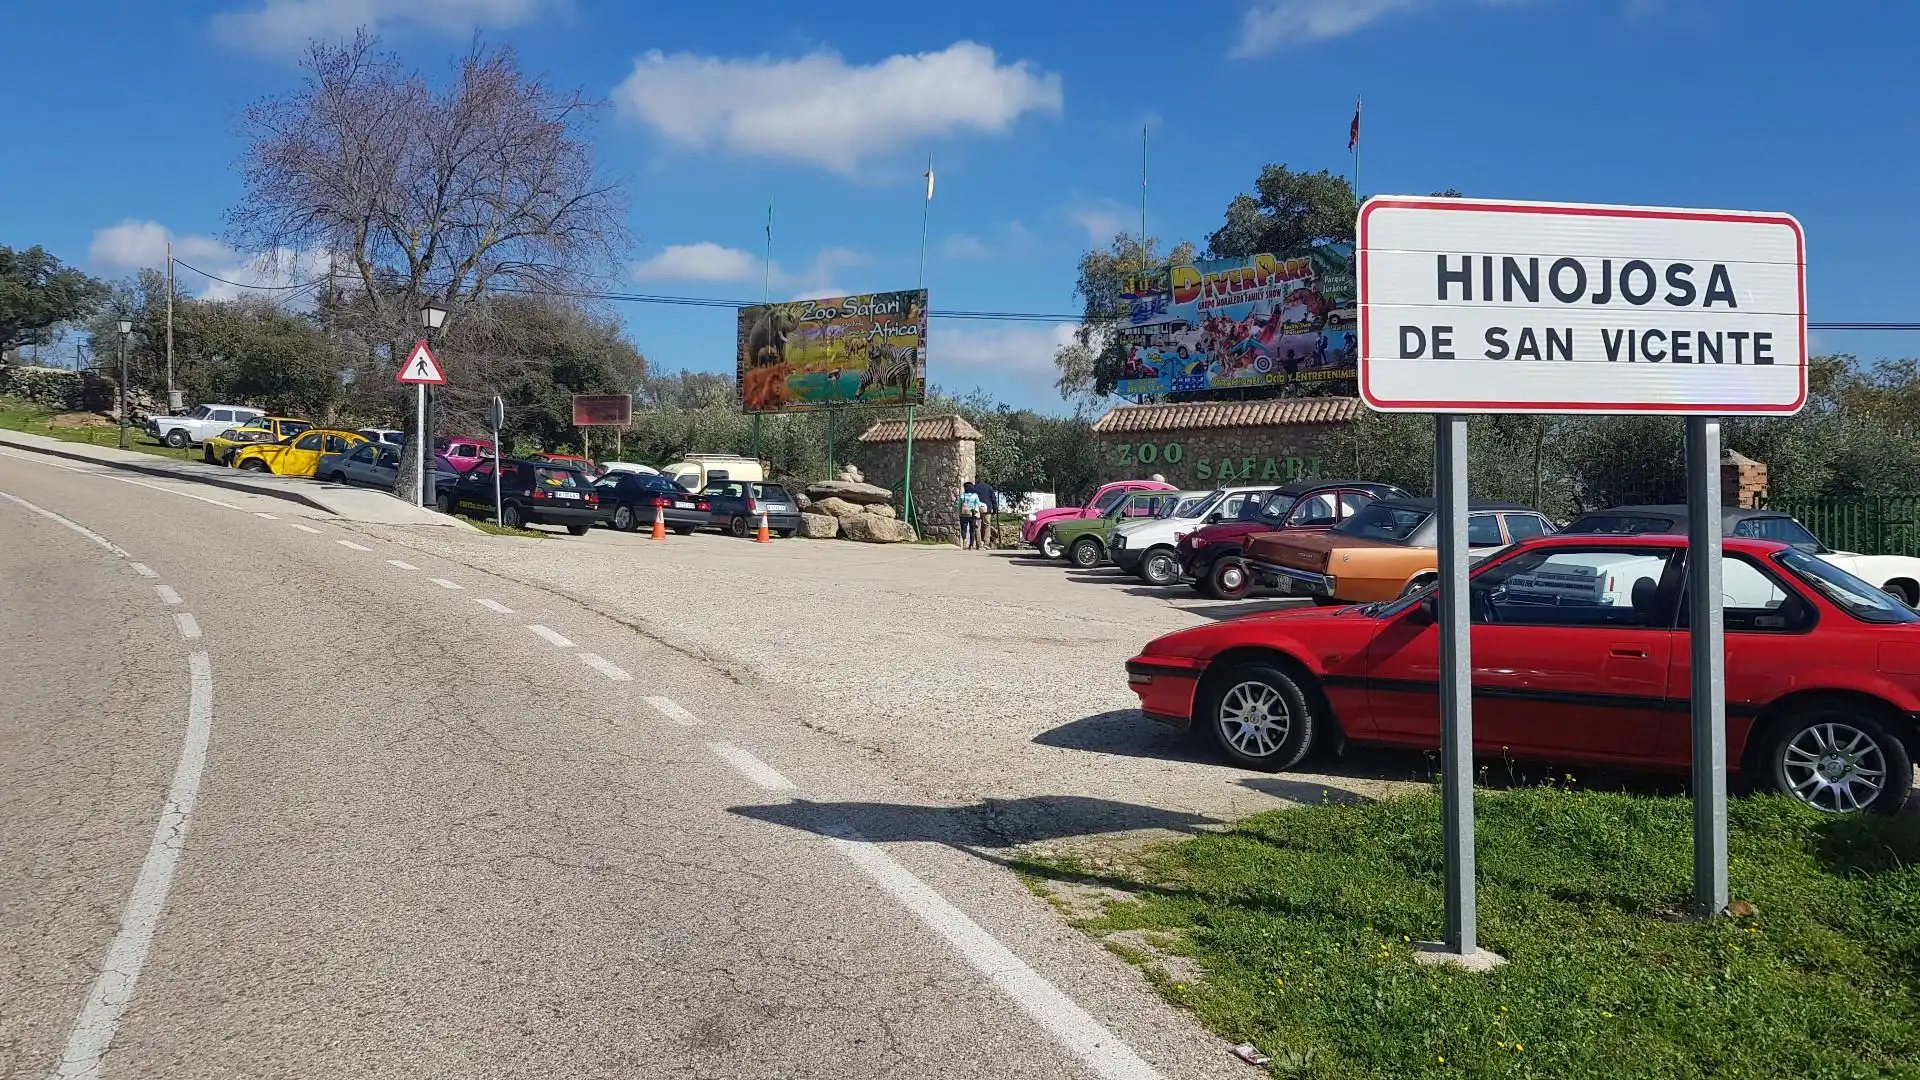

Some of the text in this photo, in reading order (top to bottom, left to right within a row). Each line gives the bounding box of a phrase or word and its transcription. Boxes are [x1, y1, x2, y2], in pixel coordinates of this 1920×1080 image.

[1437, 254, 1738, 308] HINOJOSA
[800, 294, 900, 323] Zoo Safari
[1198, 288, 1282, 310] GRUPO MORALEDA FAMILY SHOW
[867, 319, 918, 344] Africa
[1399, 325, 1775, 365] DE SAN VICENTE
[1117, 441, 1184, 466] ZOO
[1195, 455, 1323, 480] SAFARI
